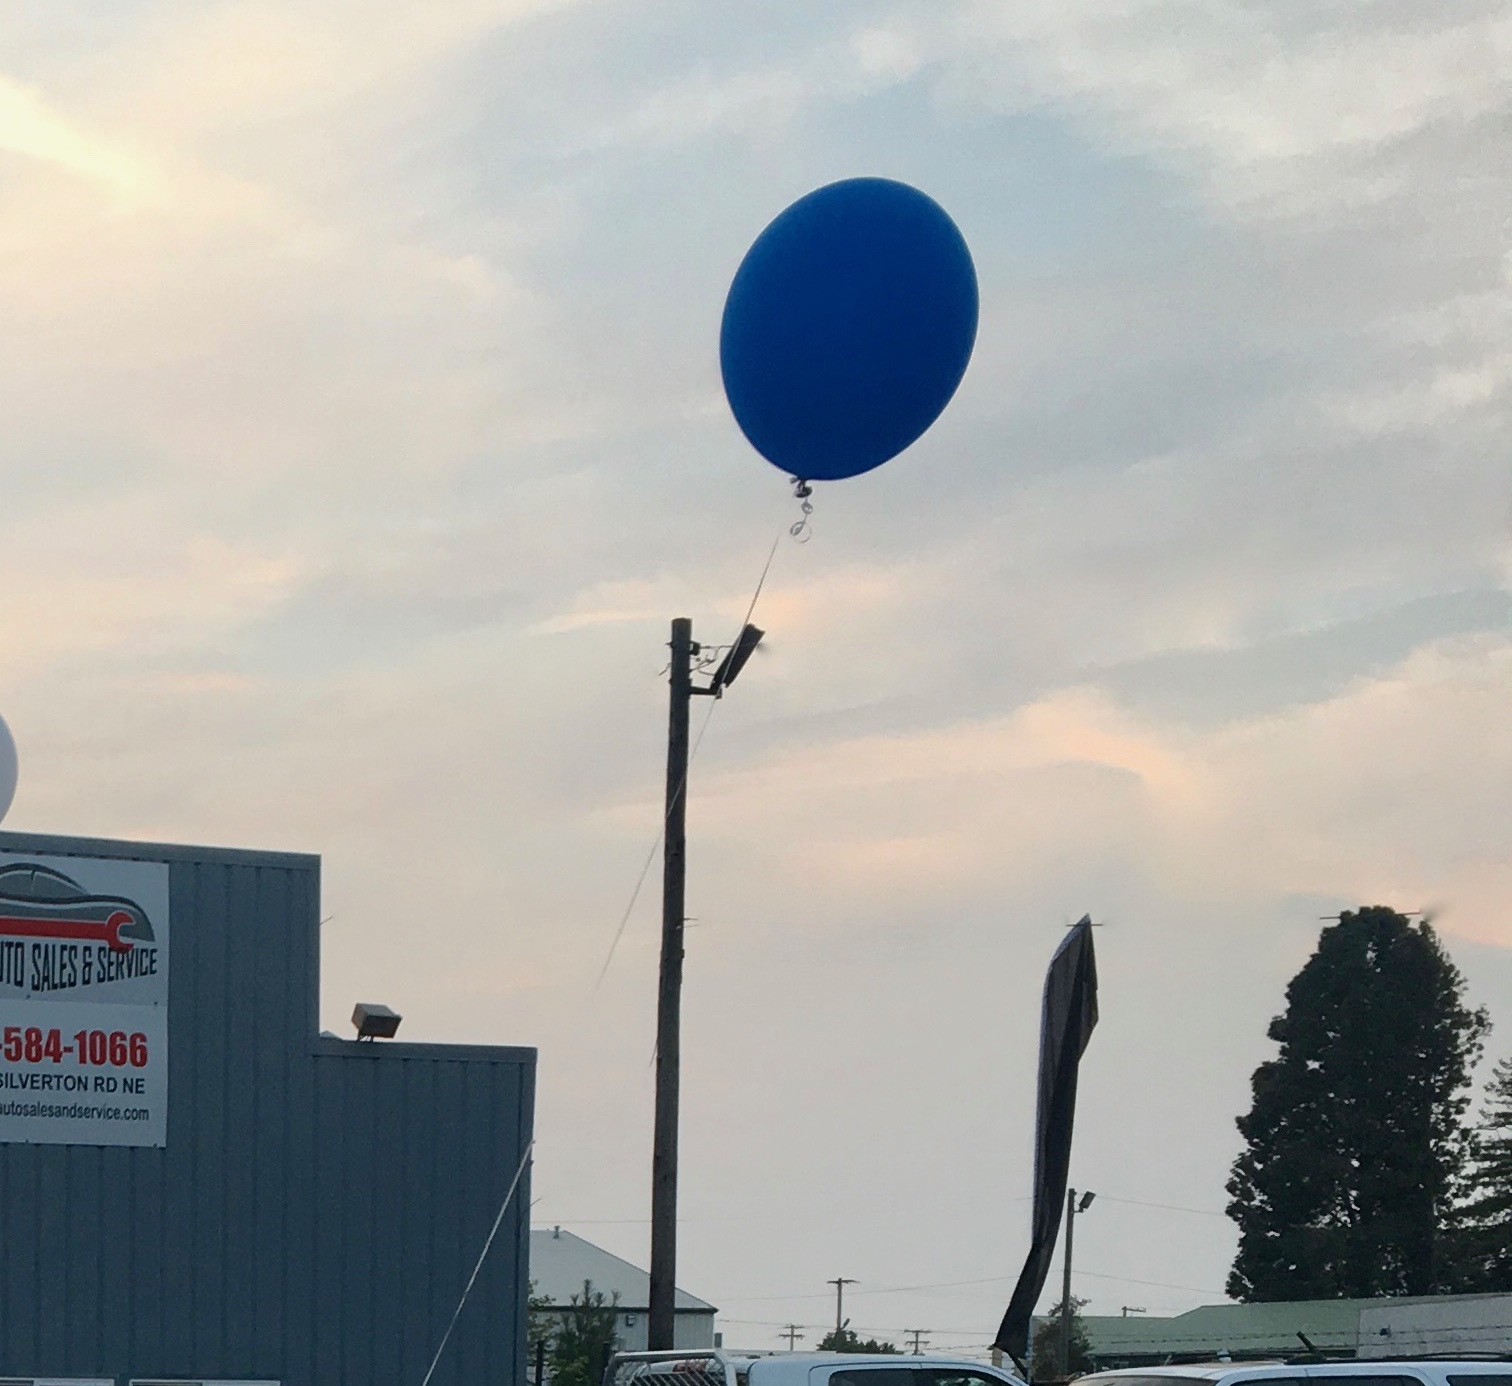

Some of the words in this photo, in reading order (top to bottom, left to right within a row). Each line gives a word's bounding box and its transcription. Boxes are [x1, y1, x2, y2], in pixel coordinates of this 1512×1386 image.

[31, 943, 77, 992] SALES
[82, 948, 93, 986] &
[97, 947, 157, 983] SERVICE
[94, 1076, 118, 1093] RD
[122, 1077, 146, 1094] NE
